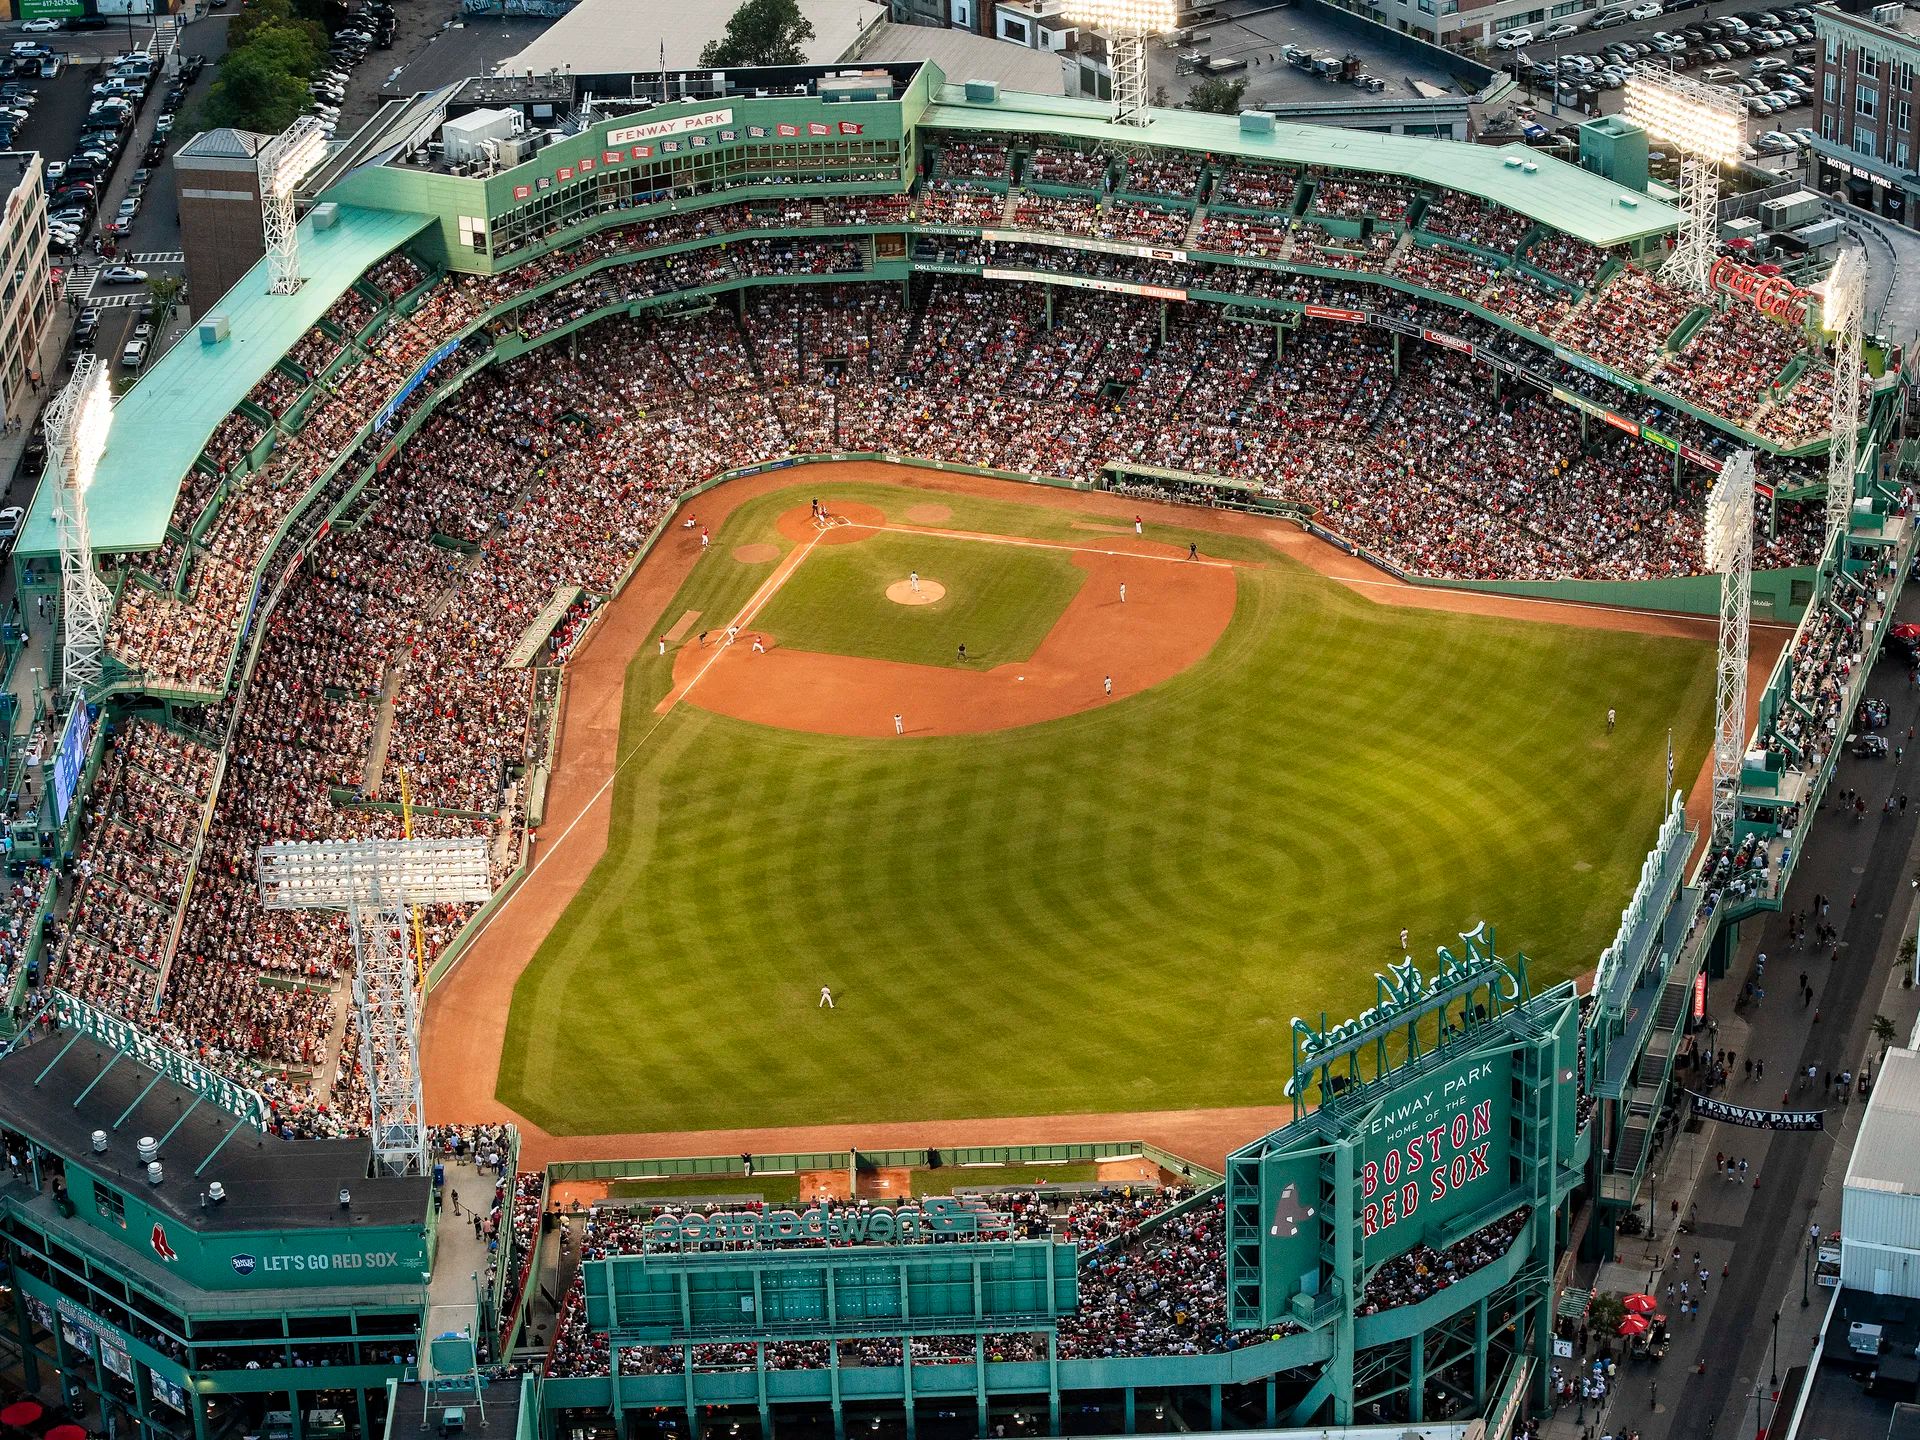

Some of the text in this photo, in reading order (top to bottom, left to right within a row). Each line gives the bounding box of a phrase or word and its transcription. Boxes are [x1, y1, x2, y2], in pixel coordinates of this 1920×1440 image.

[616, 113, 725, 142] FENWAY PARK
[1826, 156, 1892, 189] BOSTON BEER WORKS
[950, 228, 977, 236] PAVILION
[930, 264, 962, 273] Technologies
[1233, 258, 1297, 272] STATE STREET PAVILION
[1431, 333, 1467, 350] COGMEDIX
[1444, 1061, 1492, 1097] PARK
[1387, 1095, 1467, 1143] HOME OF THE
[1697, 1097, 1818, 1123] FENWAY PARK
[1361, 1099, 1492, 1199] BOSTON
[1361, 1141, 1490, 1240] RED SOX
[263, 1254, 305, 1271] LET'S
[307, 1254, 329, 1270] GO
[332, 1253, 363, 1269] RED
[365, 1251, 399, 1268] SOX
[61, 1296, 120, 1336] WELCOME TO THE
[1558, 1346, 1568, 1356] C
